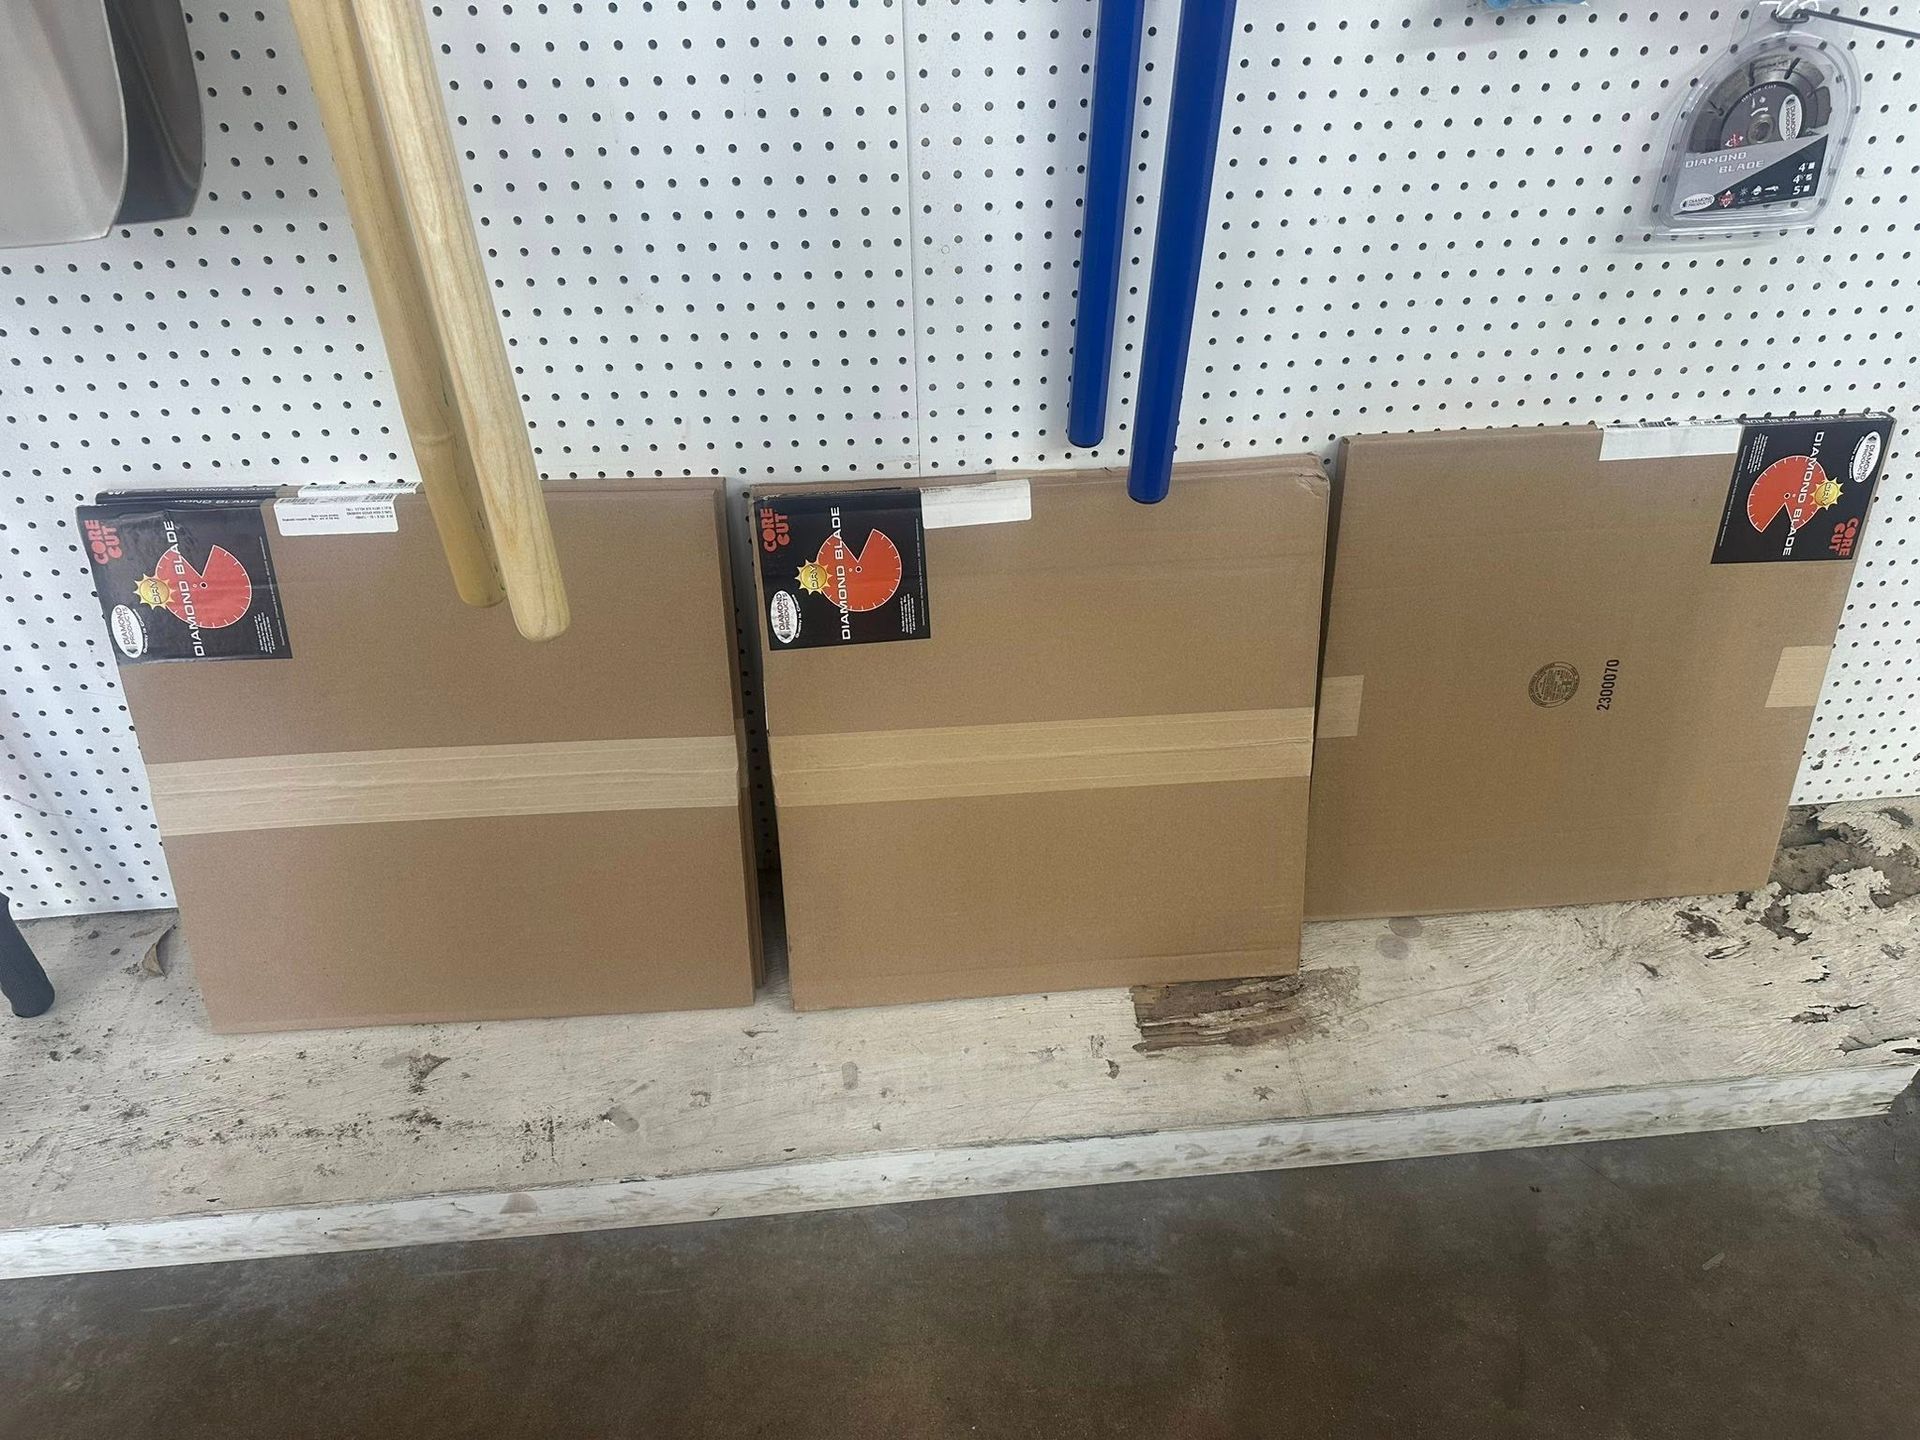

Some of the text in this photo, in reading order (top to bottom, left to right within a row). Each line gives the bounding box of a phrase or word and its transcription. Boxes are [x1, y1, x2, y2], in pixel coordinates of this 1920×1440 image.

[1685, 152, 1747, 169] DIAMOND
[1718, 160, 1764, 174] BLADE
[1860, 444, 1876, 481] DIAMOND
[1782, 431, 1825, 556] DIAMOND BLADE
[84, 519, 110, 565] CORE
[102, 525, 123, 560] CUT
[760, 507, 778, 553] CORE
[775, 512, 792, 546] CUT
[1828, 522, 1846, 553] CUT
[1838, 517, 1860, 557] CORE
[150, 578, 163, 605] DRY
[163, 520, 206, 657] DIAMOND BLADE
[809, 563, 819, 590] DRY
[830, 506, 851, 640] DIAMOND BLADE
[115, 606, 131, 646] DIAMOND
[123, 606, 139, 646] PRODUCTS
[776, 592, 787, 631] DIAMOND
[783, 592, 792, 631] PRODUCTS
[1596, 659, 1620, 711] 2300070
